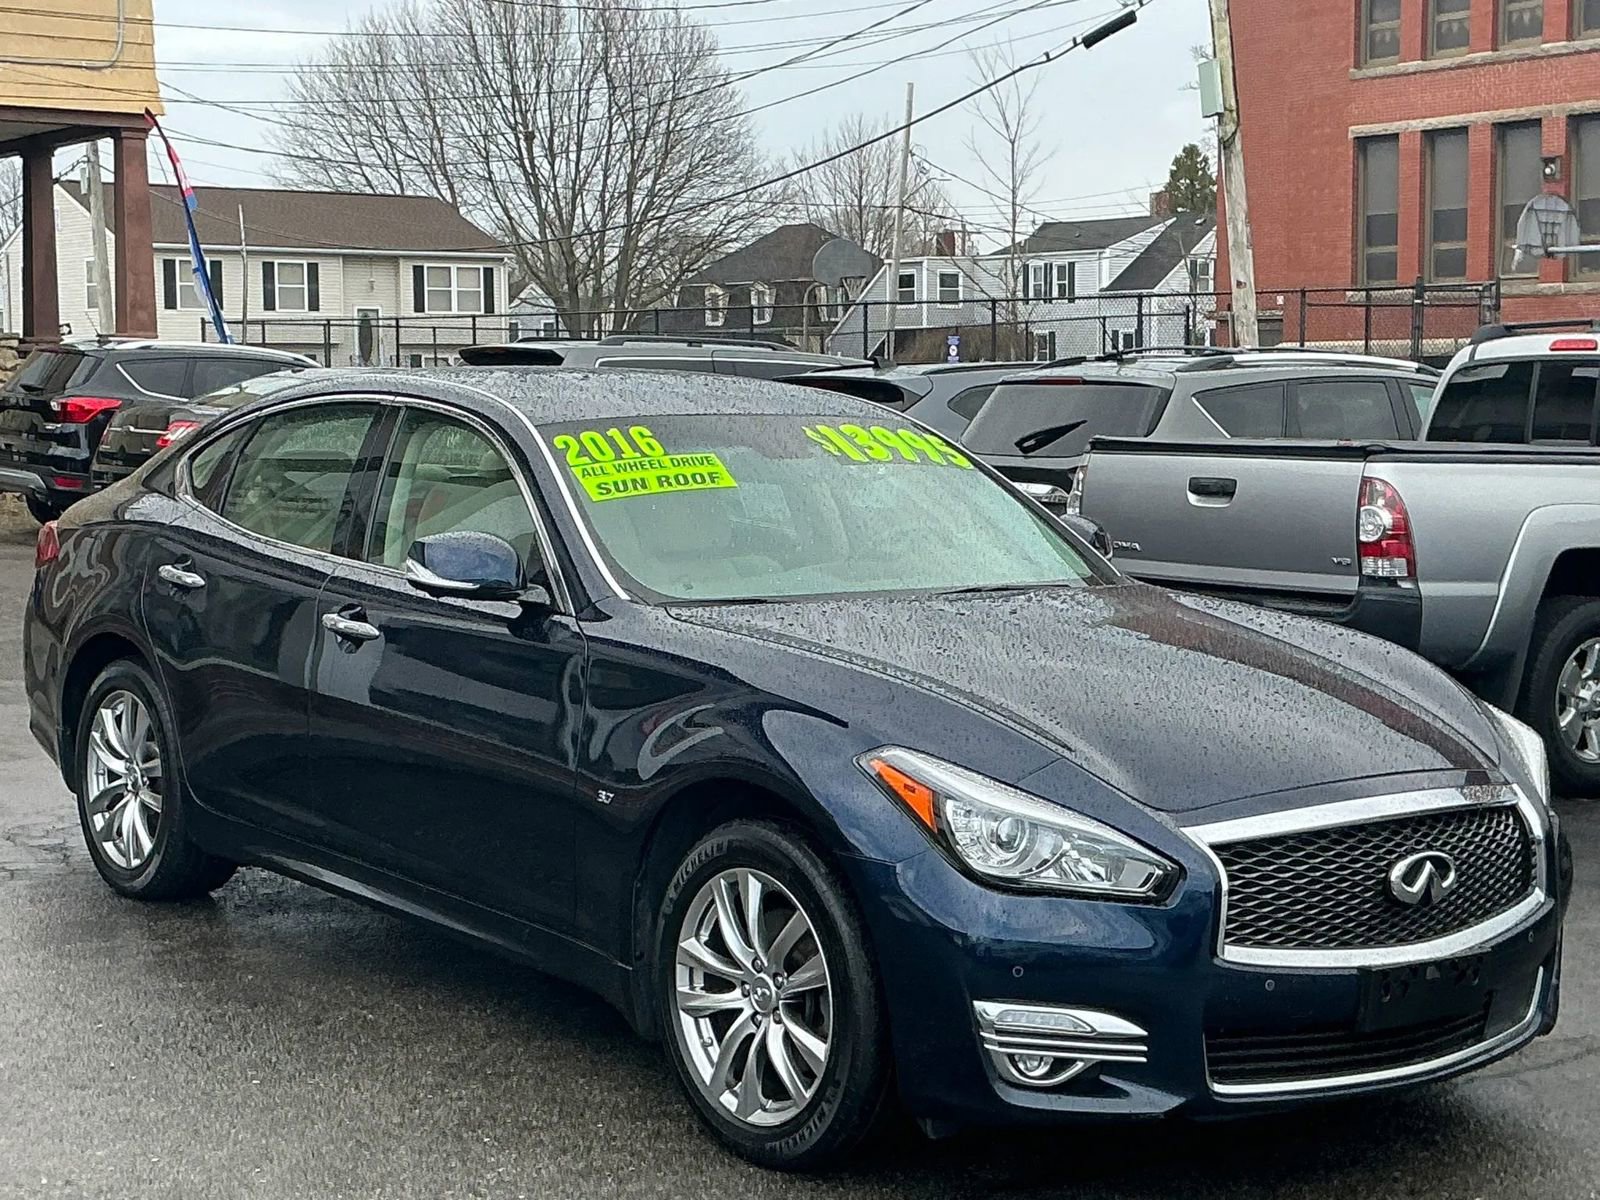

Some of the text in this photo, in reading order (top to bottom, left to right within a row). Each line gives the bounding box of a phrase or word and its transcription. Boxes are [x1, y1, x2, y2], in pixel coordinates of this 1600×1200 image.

[553, 426, 665, 466] 2016
[801, 423, 974, 469] $13995
[582, 455, 717, 479] ALL WHEEL DRIVE
[597, 472, 721, 496] SUN ROOF
[667, 838, 728, 899] MICHELIN
